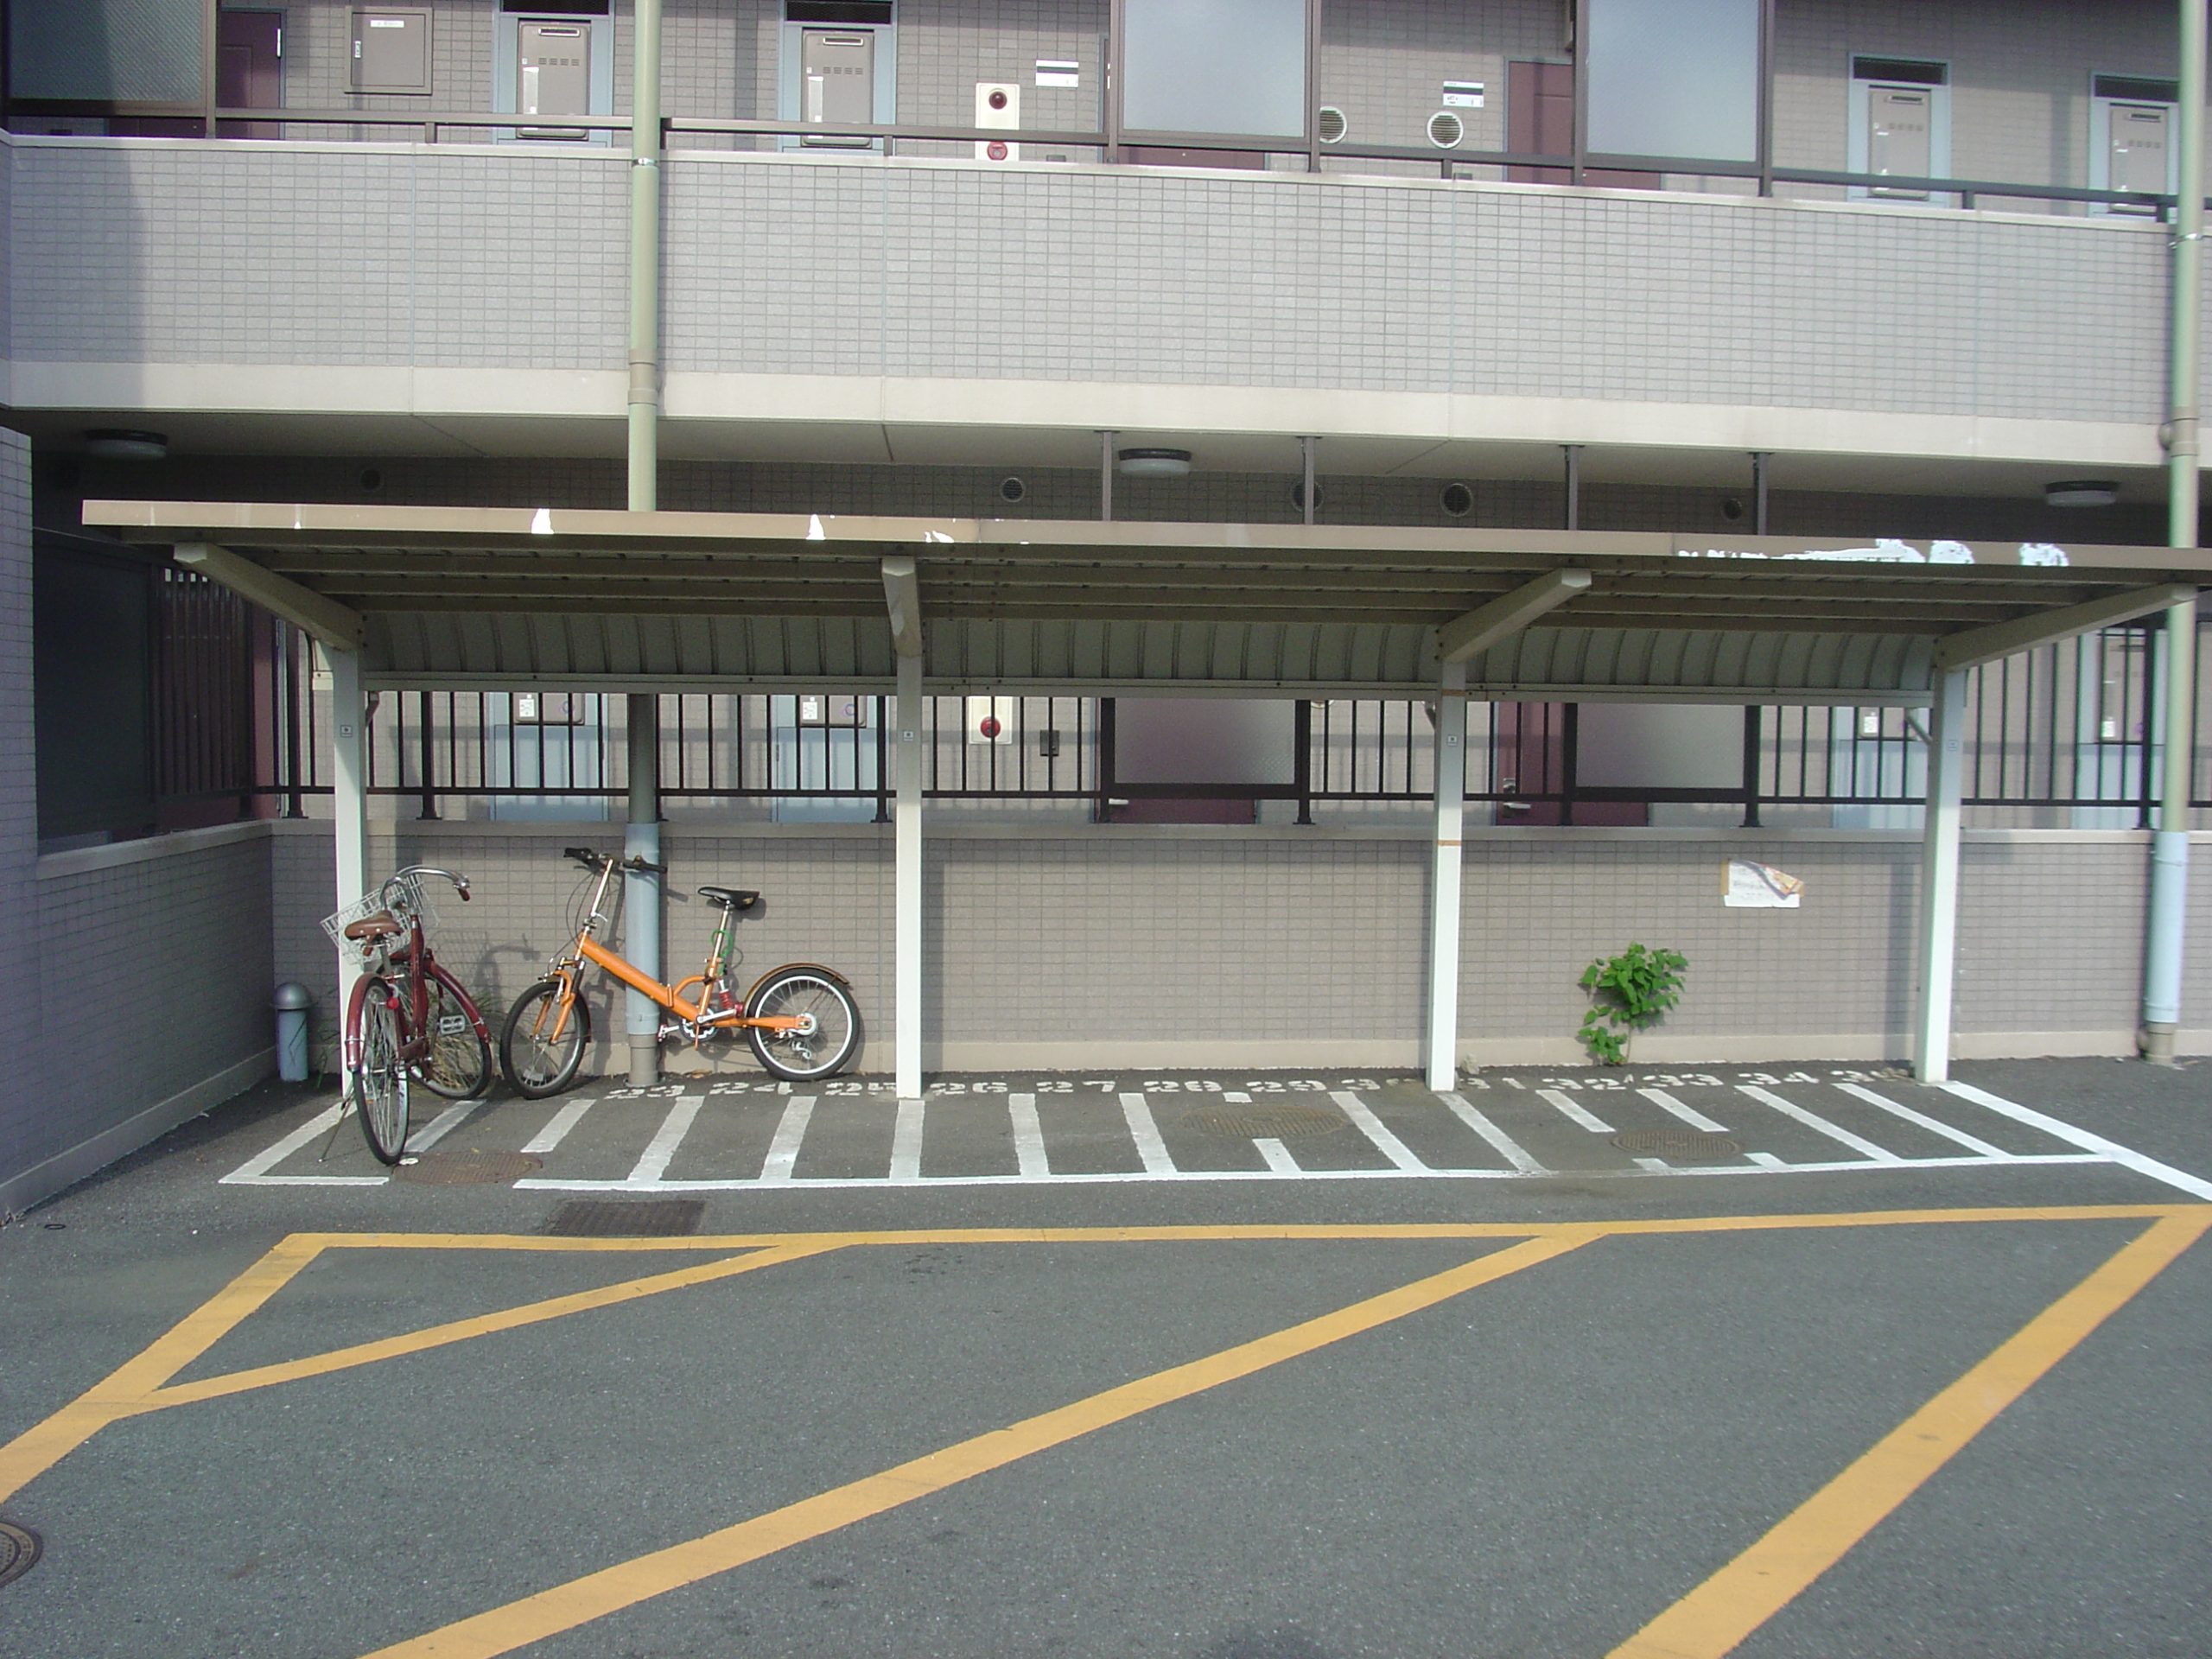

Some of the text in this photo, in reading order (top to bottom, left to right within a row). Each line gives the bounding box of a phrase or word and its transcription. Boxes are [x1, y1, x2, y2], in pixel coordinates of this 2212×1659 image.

[1643, 1073, 1724, 1087] 33
[1738, 1071, 1820, 1084] 34
[709, 1082, 793, 1095] 24
[930, 1082, 1008, 1096] 26
[1036, 1081, 1116, 1093] 27
[1143, 1081, 1223, 1093] 28
[1246, 1080, 1327, 1092] 29
[1542, 1078, 1627, 1090] 32
